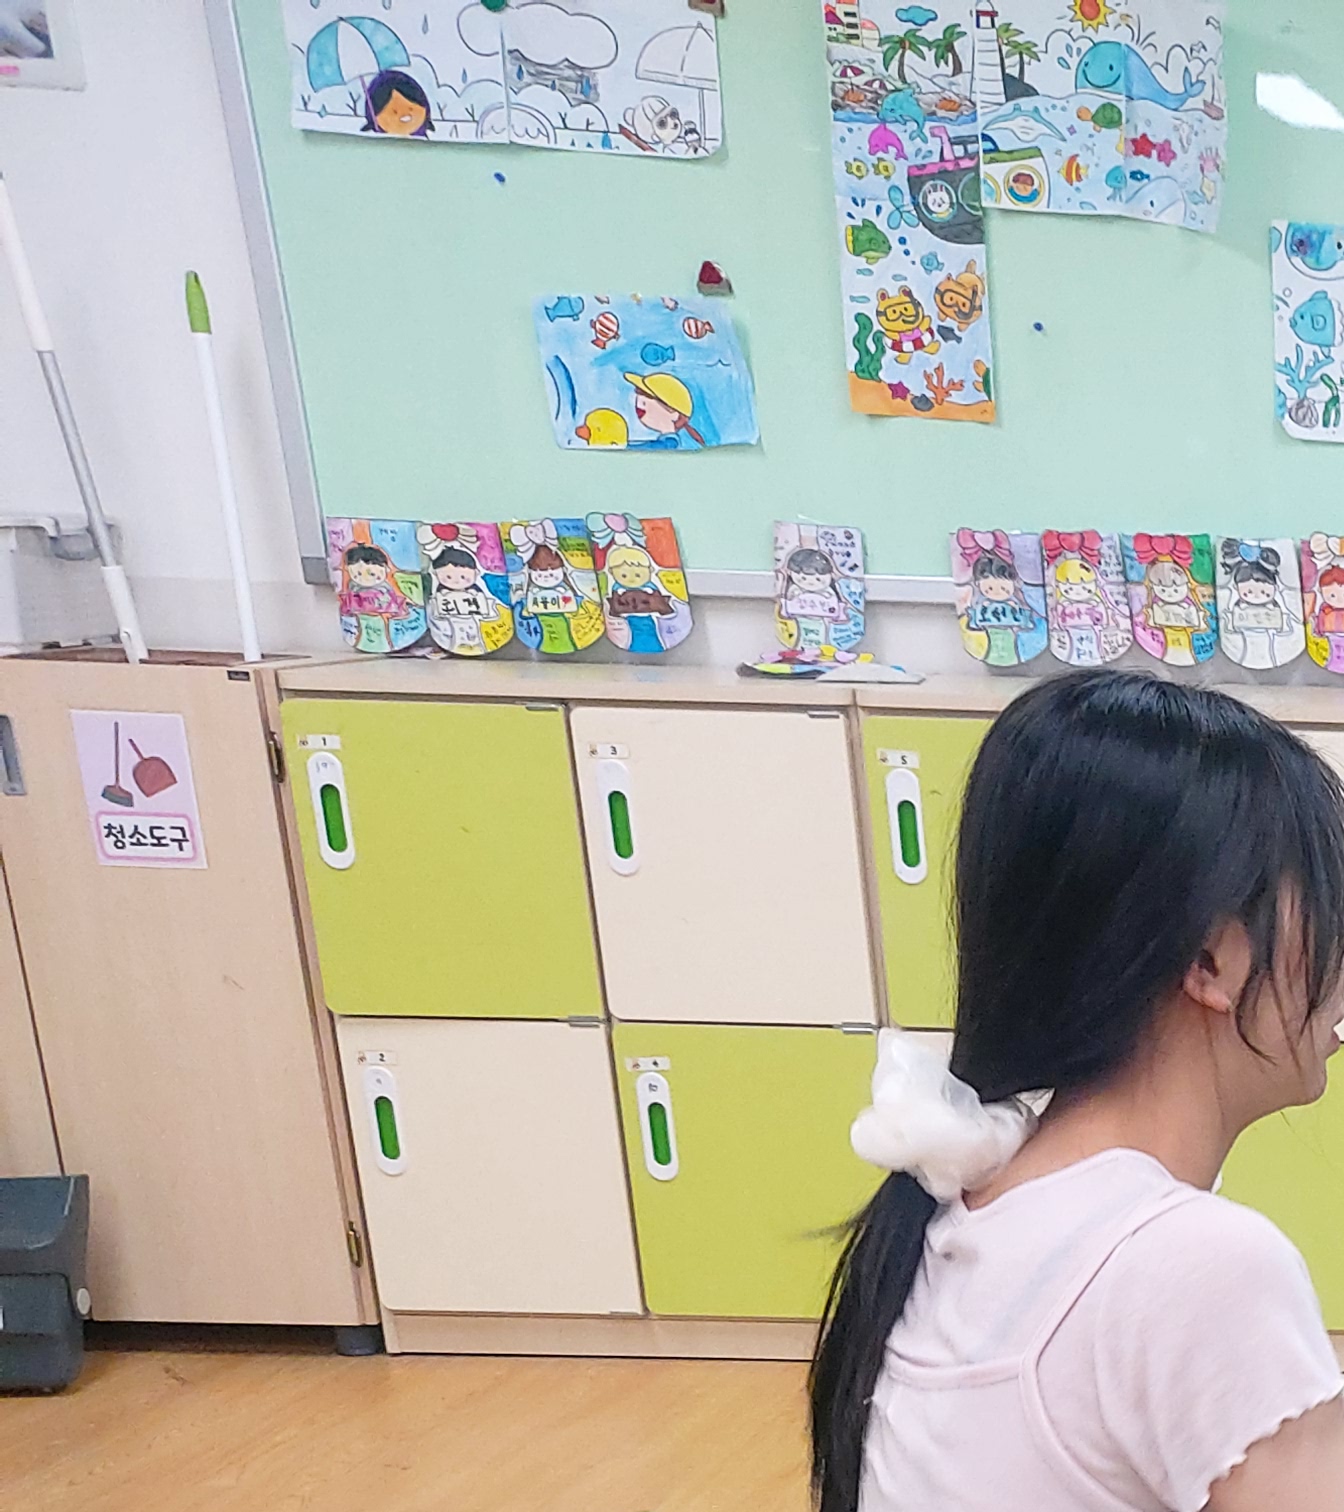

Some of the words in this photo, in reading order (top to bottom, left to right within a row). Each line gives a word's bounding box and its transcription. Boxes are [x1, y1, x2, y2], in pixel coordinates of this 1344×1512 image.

[610, 745, 618, 756] 3
[900, 754, 908, 766] 5
[103, 822, 190, 852] 청소도구
[378, 1052, 386, 1063] 2
